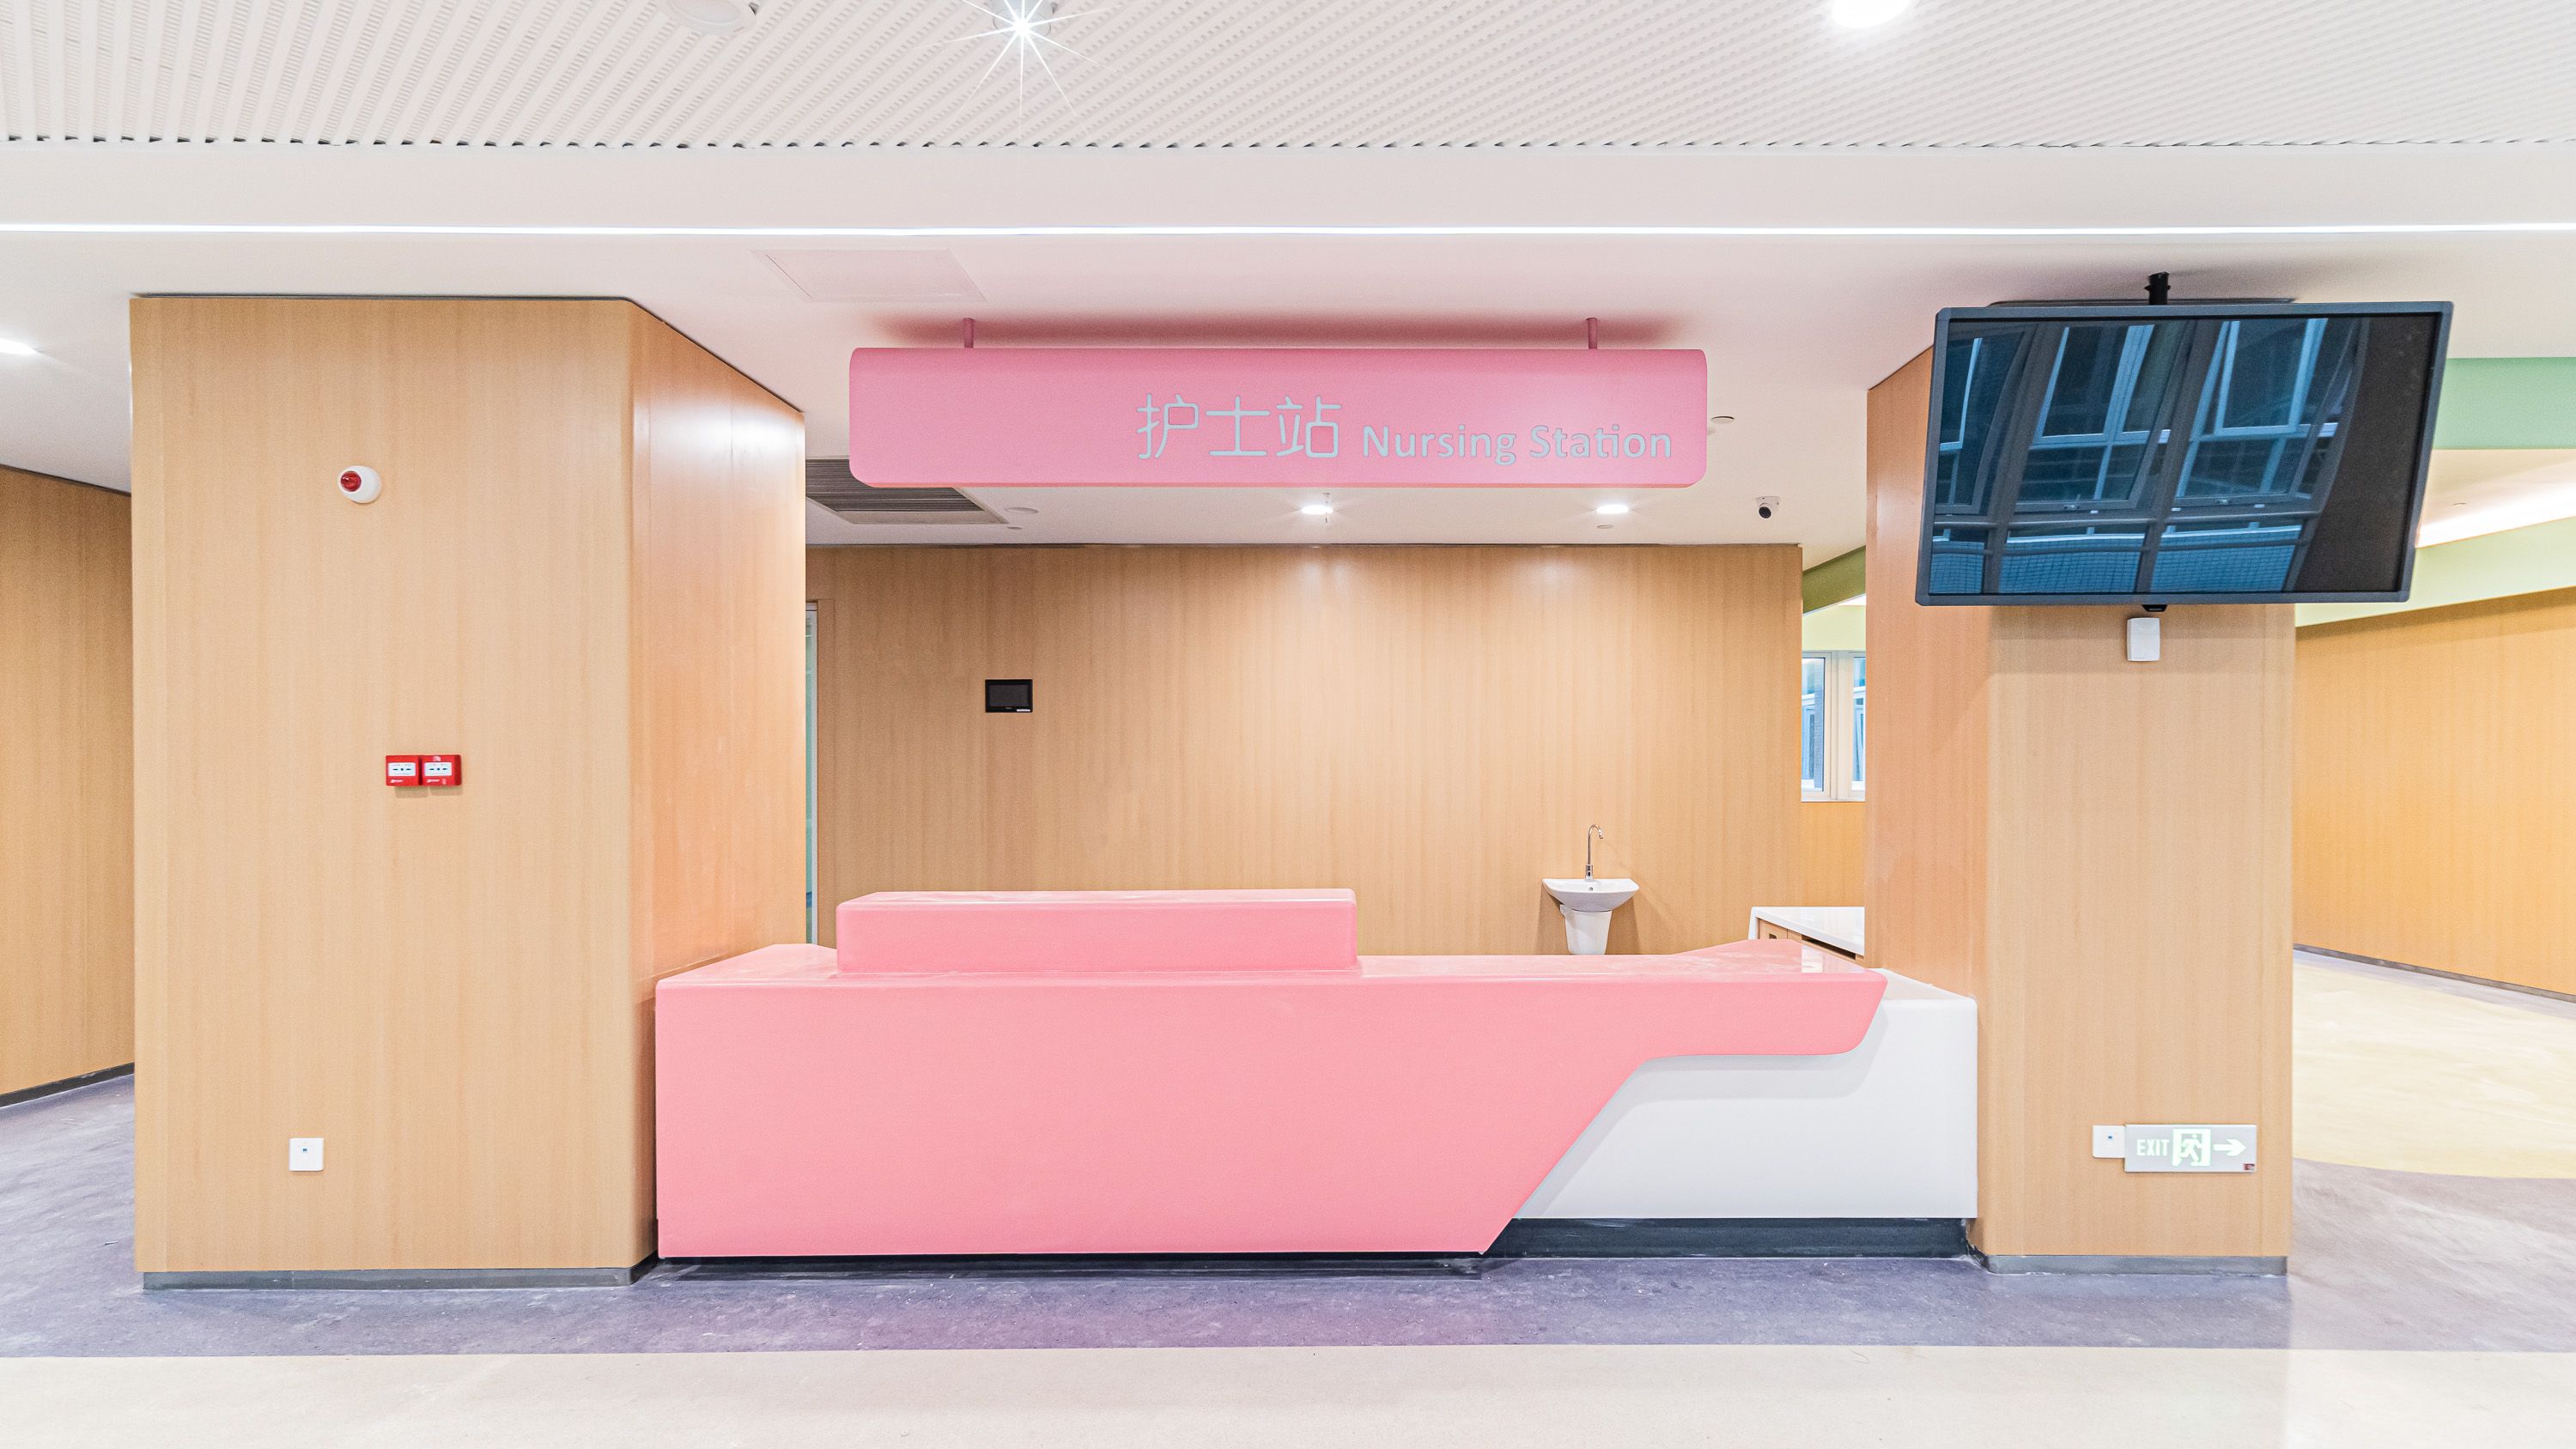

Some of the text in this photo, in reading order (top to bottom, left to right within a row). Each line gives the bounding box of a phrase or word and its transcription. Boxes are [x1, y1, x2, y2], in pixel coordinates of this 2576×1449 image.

[1136, 393, 1342, 459] 护士站
[1362, 424, 1673, 465] Nursing Station
[2136, 1138, 2170, 1156] EXIT
